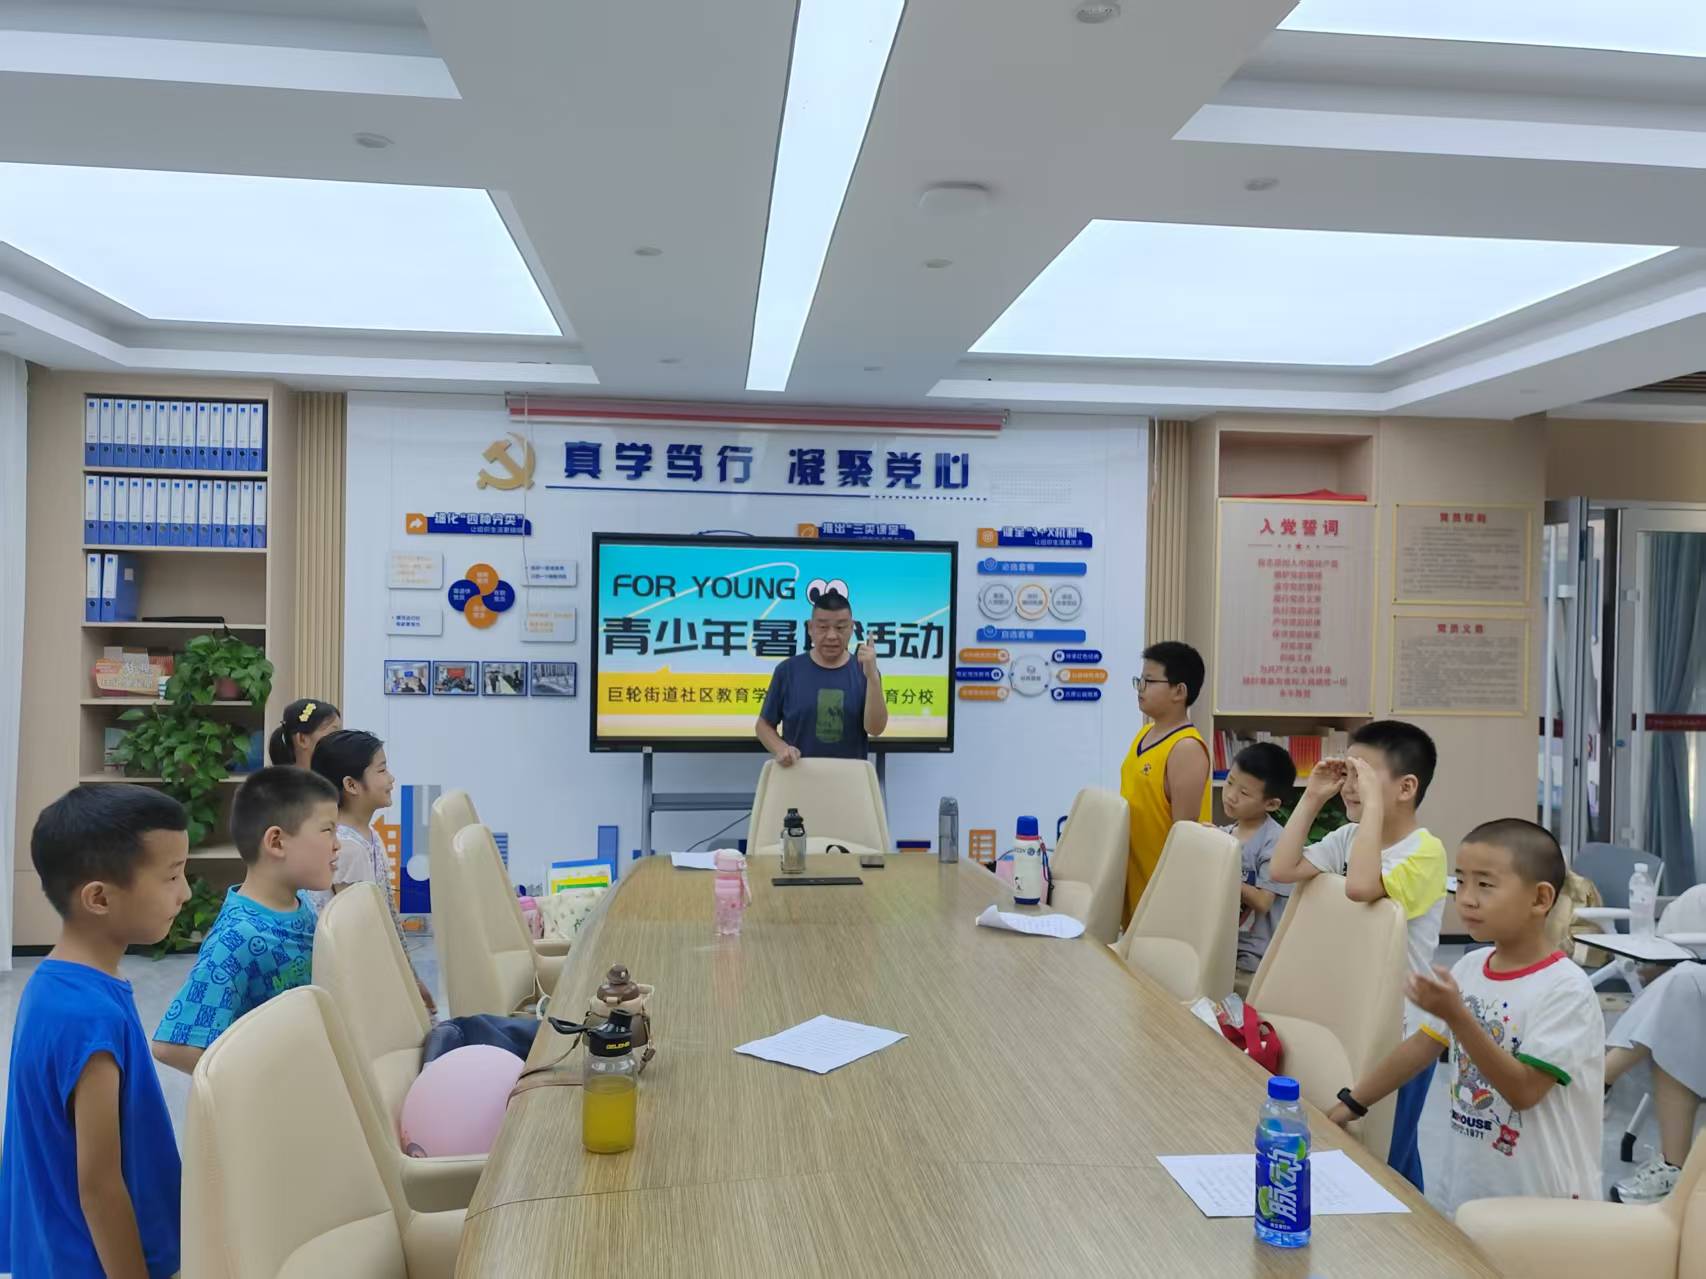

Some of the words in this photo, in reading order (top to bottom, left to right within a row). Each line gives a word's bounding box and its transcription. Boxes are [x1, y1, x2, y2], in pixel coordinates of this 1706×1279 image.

[564, 441, 753, 483] 真学笃行
[787, 448, 969, 489] 凝聚党心
[1260, 518, 1339, 536] 入党誓词
[612, 574, 676, 597] FOR
[692, 576, 796, 600] YOUNG
[603, 616, 944, 660] 青少年暑活动
